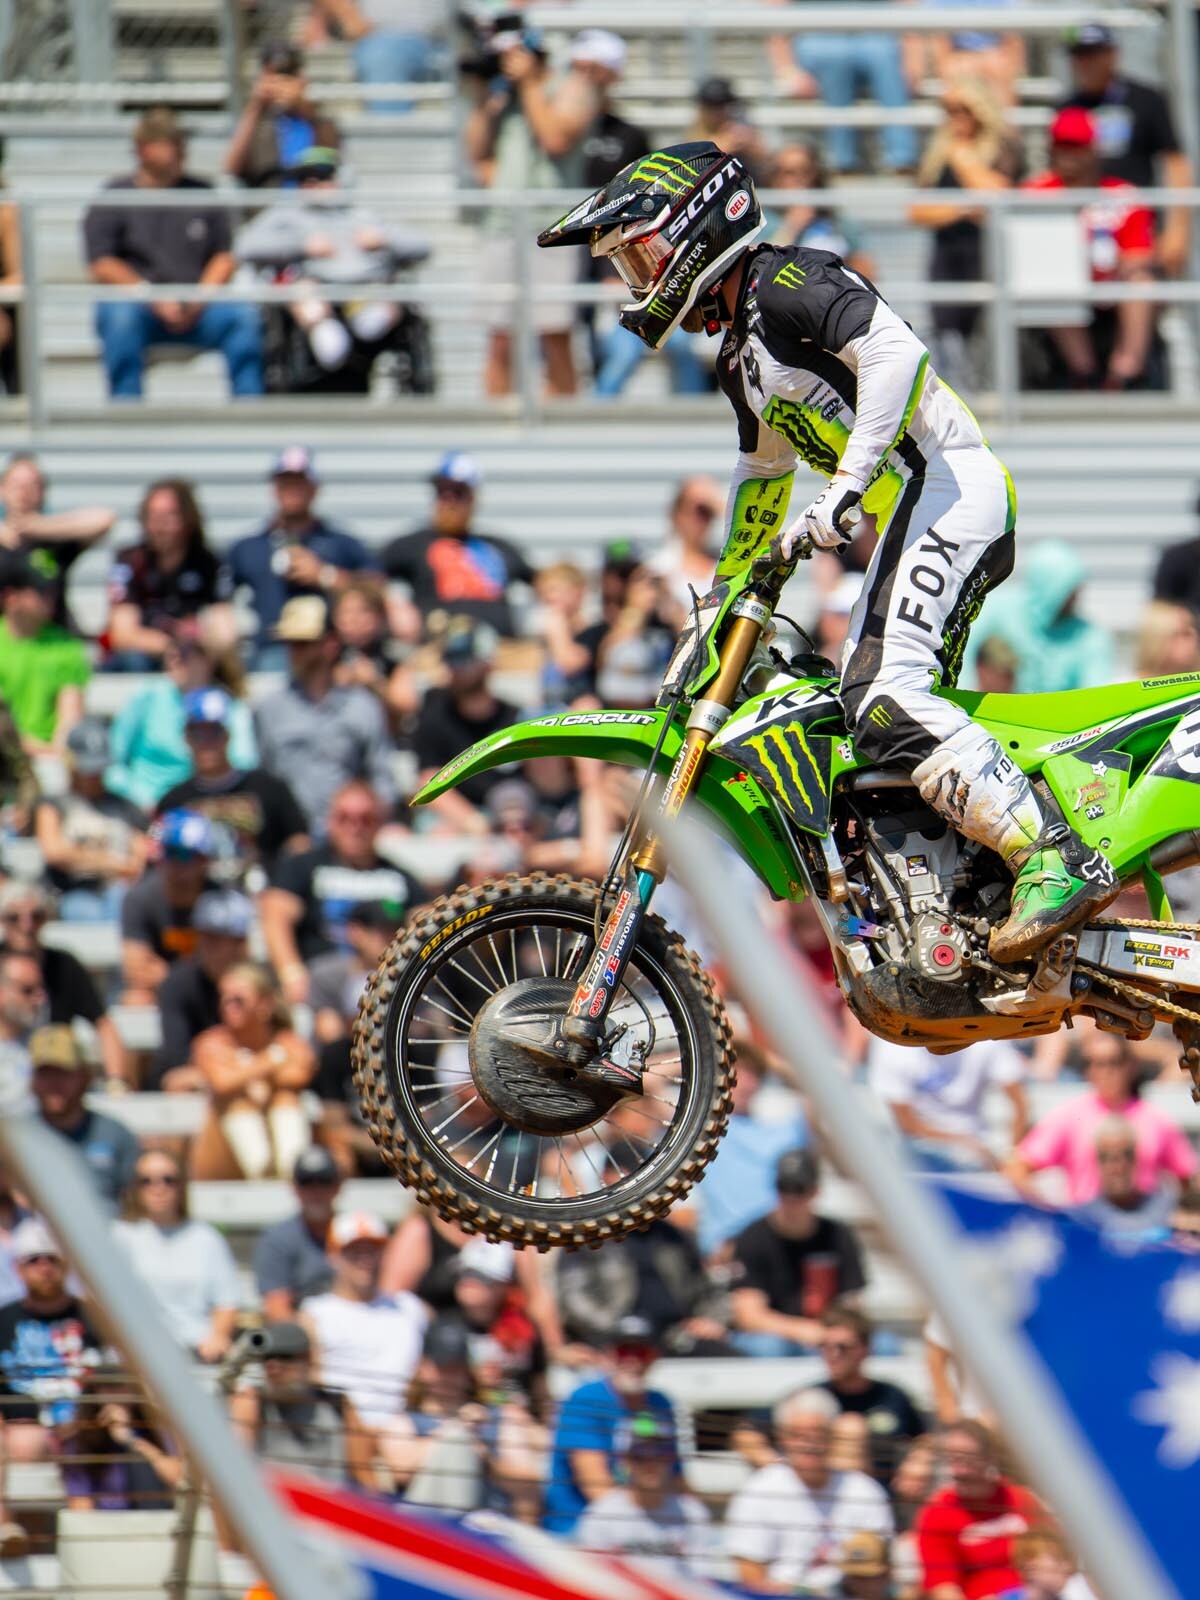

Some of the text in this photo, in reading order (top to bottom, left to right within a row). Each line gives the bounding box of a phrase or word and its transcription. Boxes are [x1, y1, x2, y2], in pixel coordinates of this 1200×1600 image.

[729, 195, 748, 216] BELL
[661, 241, 708, 299] MONSTER
[676, 255, 706, 297] ENERGY
[805, 481, 839, 520] FOX
[896, 527, 960, 633] FOX
[1142, 673, 1200, 689] Kawasaki
[560, 712, 655, 726] CIRCUIT
[754, 681, 841, 724] KX
[661, 738, 689, 805] CIRCUIT
[672, 747, 701, 810] SHOWA
[1086, 805, 1104, 818] PPG
[420, 904, 494, 960] DUNLOP
[603, 912, 636, 986] JE PISTONS
[1163, 945, 1191, 958] RK
